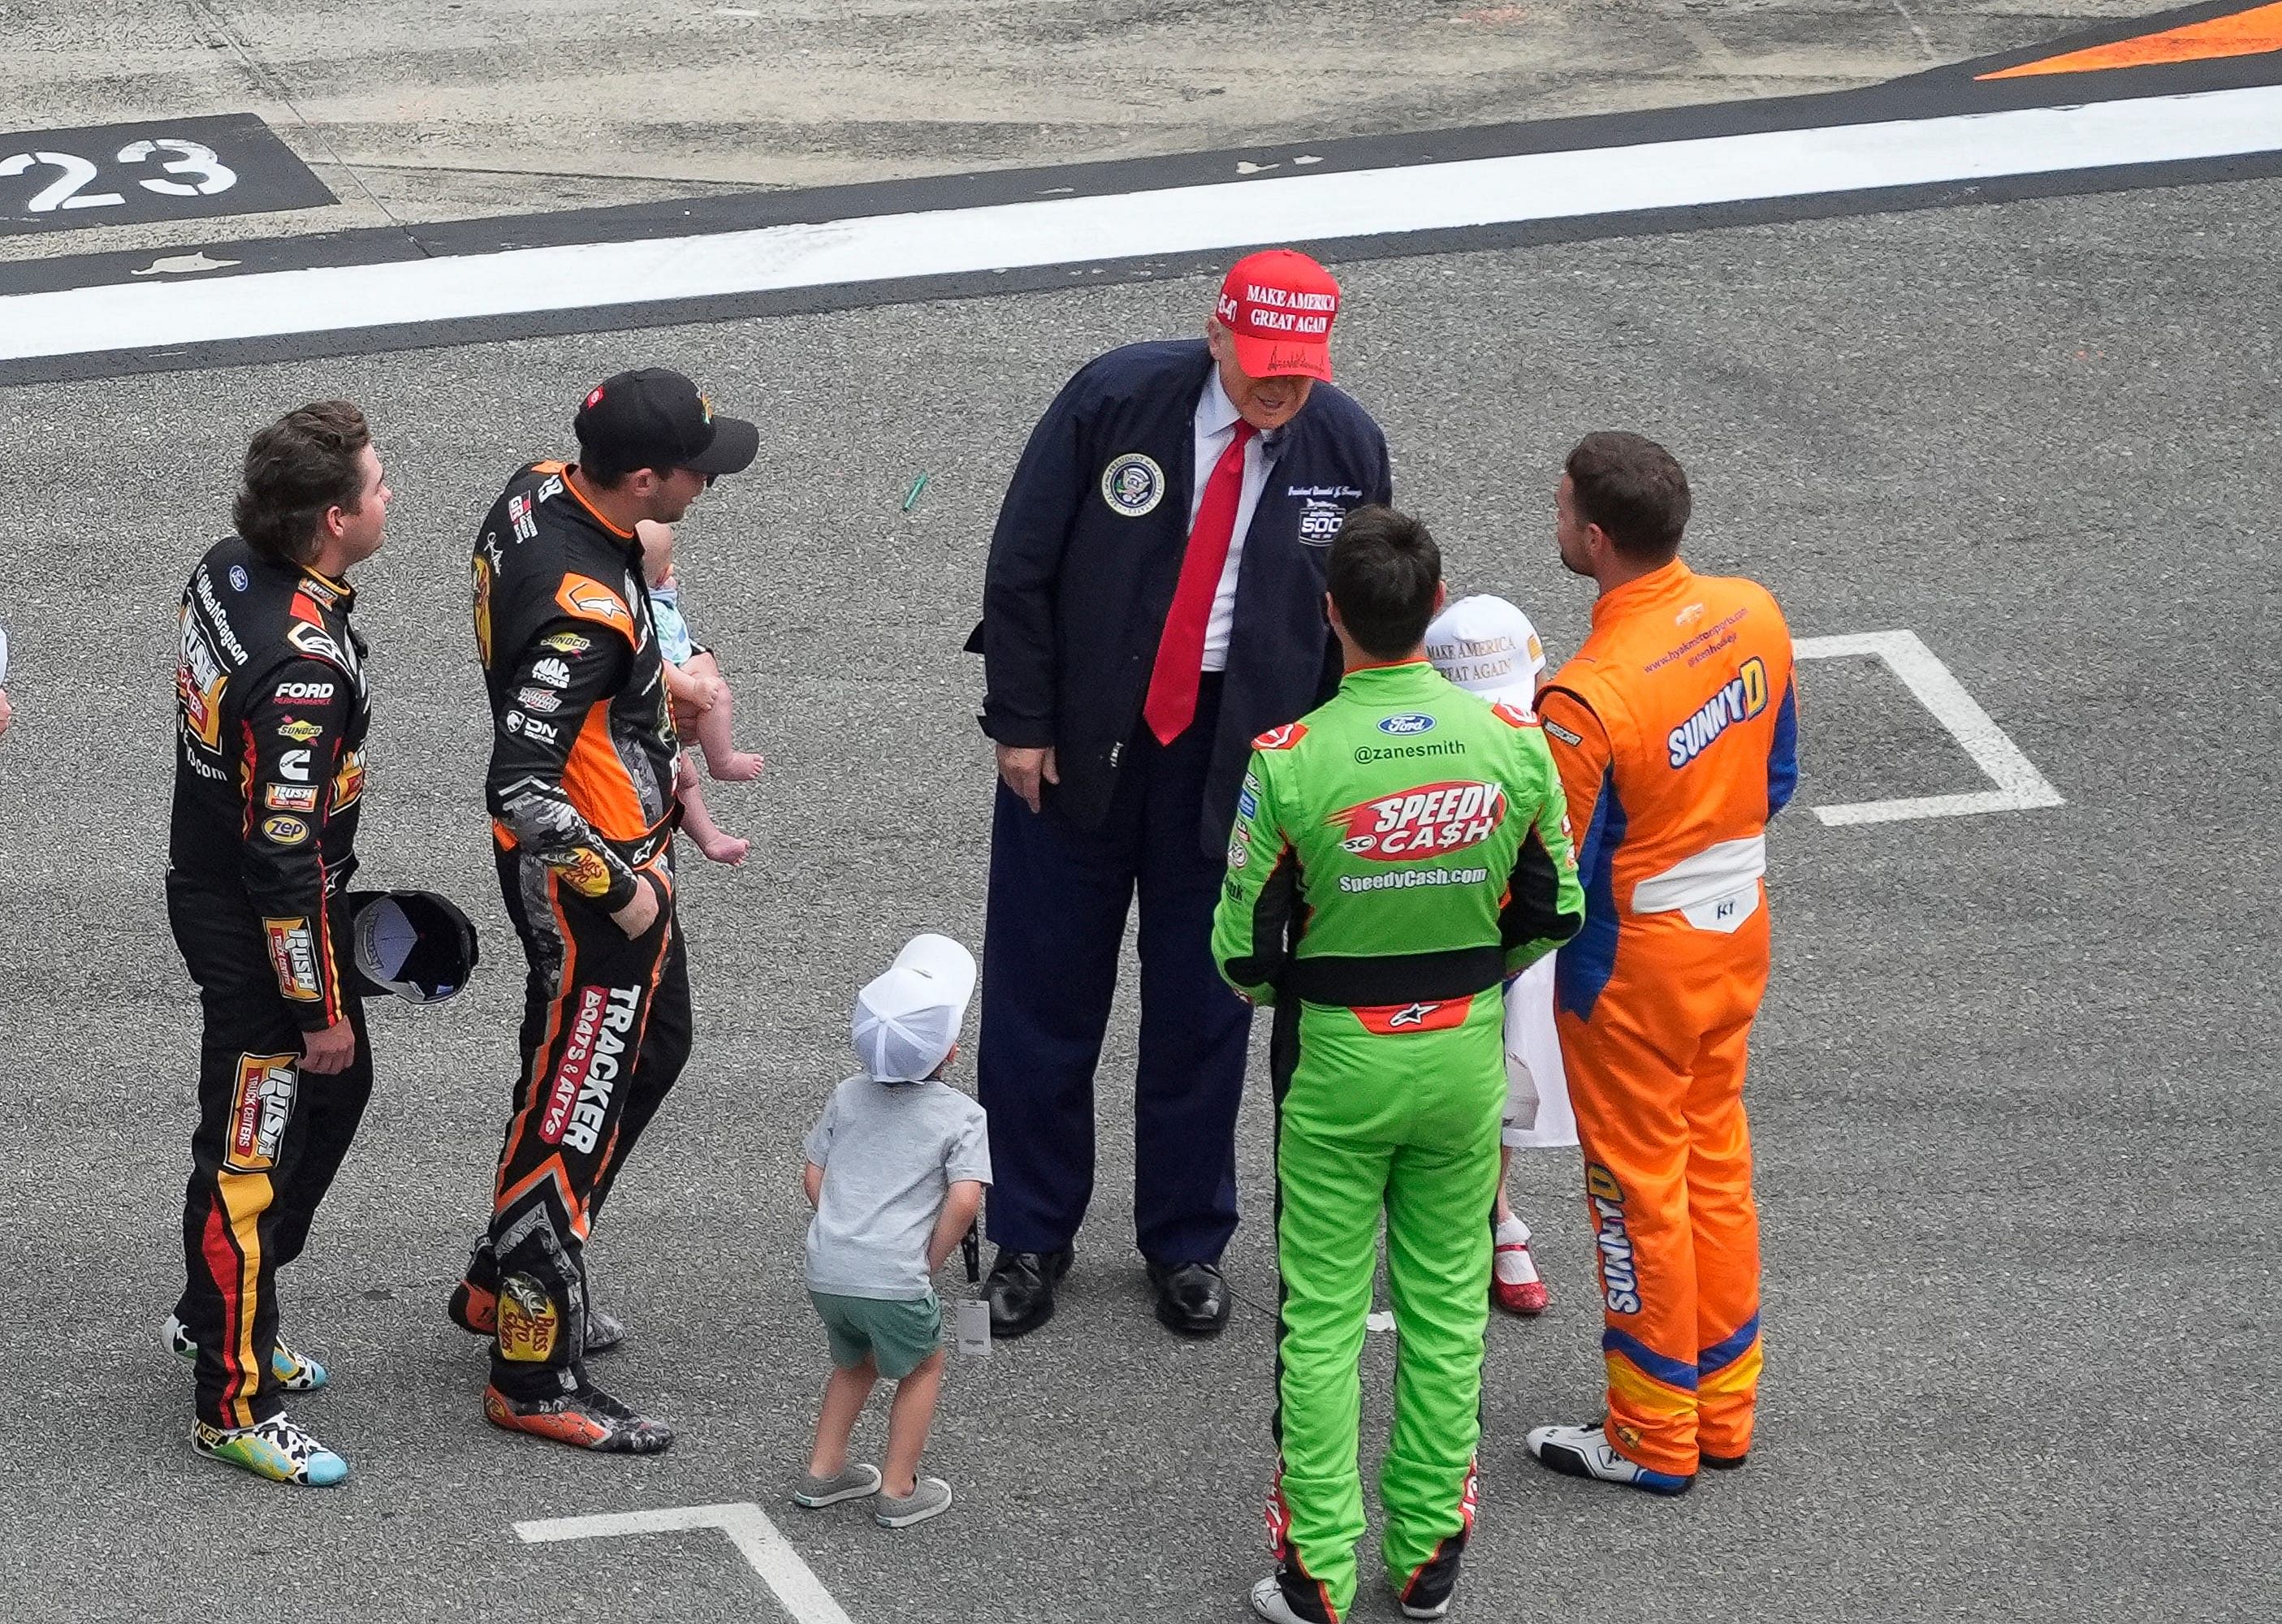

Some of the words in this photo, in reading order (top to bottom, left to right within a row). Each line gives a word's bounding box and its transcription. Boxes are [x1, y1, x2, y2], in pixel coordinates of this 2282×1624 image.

[0, 138, 238, 214] 23
[1246, 283, 1286, 307] MAKE
[1286, 292, 1336, 312] AMERICA
[1250, 309, 1296, 330] GREAT
[1295, 315, 1329, 334] AGAIN
[508, 495, 525, 522] GR
[1301, 517, 1343, 533] 500
[1425, 643, 1456, 660] MAKE
[1458, 636, 1517, 659] AMERICA
[533, 658, 570, 683] MAC
[1472, 658, 1512, 680] AGAIN
[275, 682, 335, 698] FORD
[280, 725, 322, 736] SUNOCO
[525, 717, 559, 739] DN
[1387, 715, 1427, 732] Ford
[1354, 739, 1466, 765] @zanesmith
[1368, 782, 1502, 833] SPEEDY
[1343, 837, 1371, 850] SC
[1380, 816, 1493, 853] CA$H
[1339, 866, 1489, 892] SpeedyCash.com
[284, 928, 317, 991] RUSH
[568, 990, 603, 1061] BOATS
[562, 984, 642, 1155] TRACKER
[563, 1063, 580, 1074] &
[245, 1074, 260, 1106] TRUCK
[257, 1065, 295, 1157] RUSH
[238, 1107, 257, 1148] CENTERS
[533, 1315, 556, 1353] Bass
